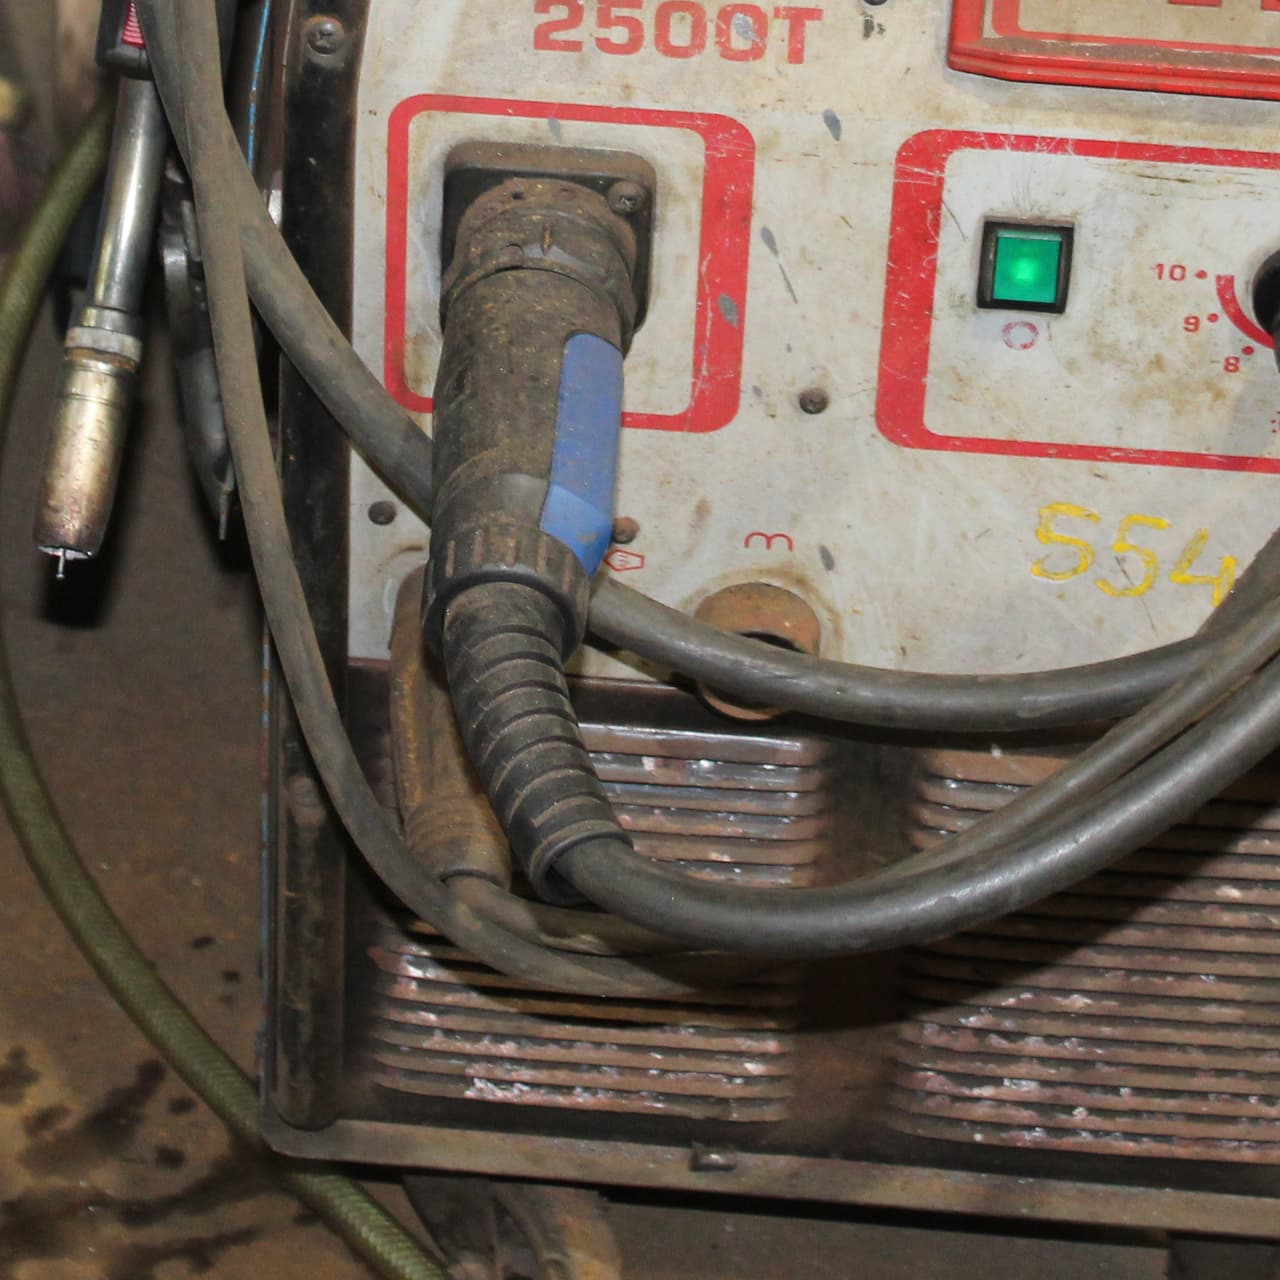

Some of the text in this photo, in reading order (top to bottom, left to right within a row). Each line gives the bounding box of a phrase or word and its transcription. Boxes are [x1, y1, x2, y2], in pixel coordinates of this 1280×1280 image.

[1154, 263, 1187, 282] 10
[1183, 315, 1201, 333] 9
[1223, 355, 1241, 374] 8
